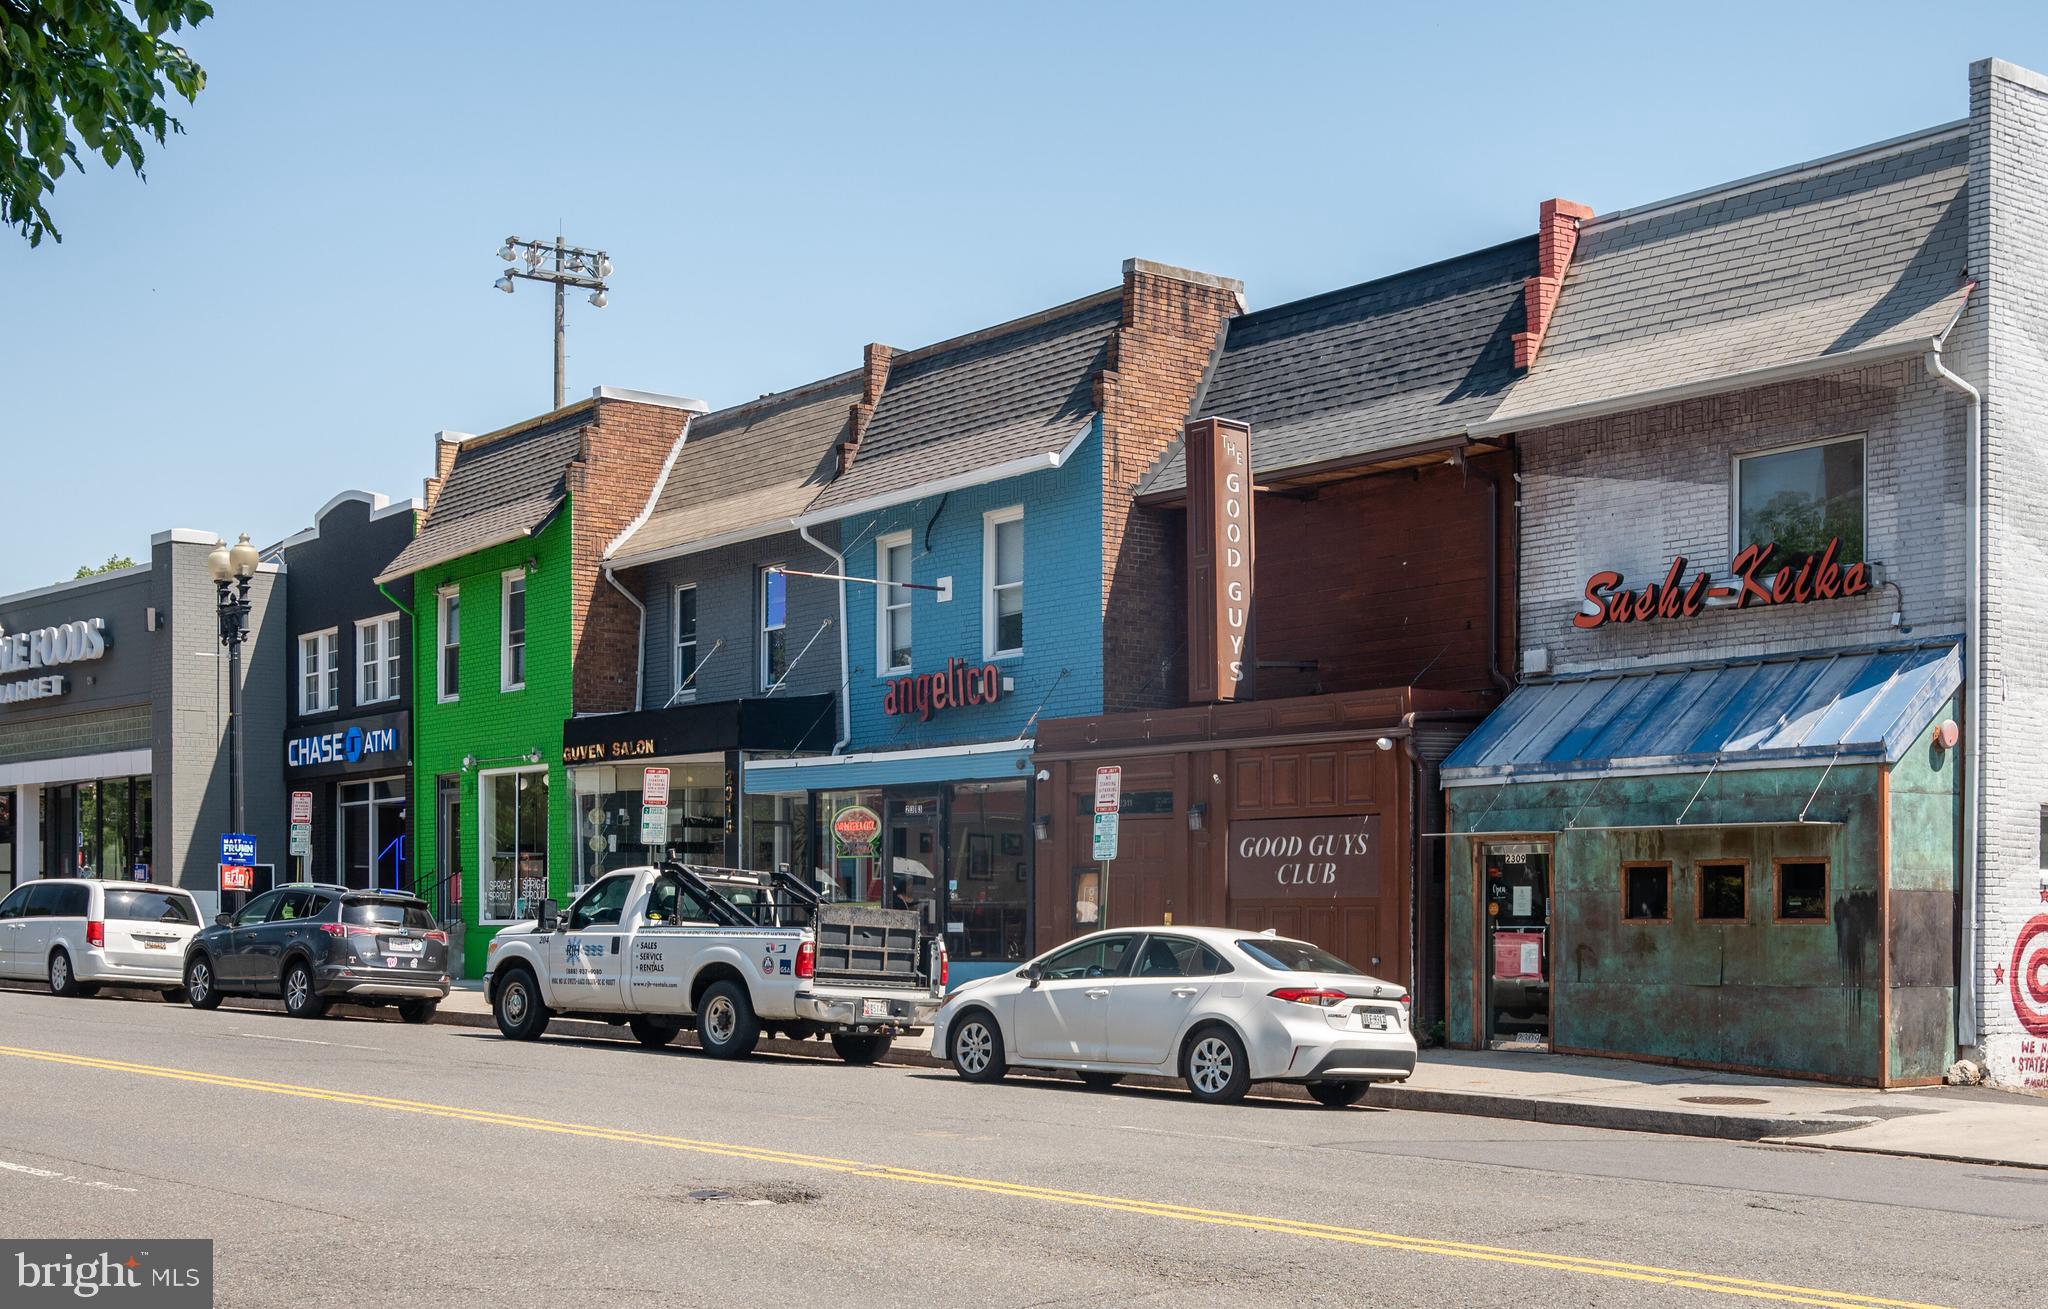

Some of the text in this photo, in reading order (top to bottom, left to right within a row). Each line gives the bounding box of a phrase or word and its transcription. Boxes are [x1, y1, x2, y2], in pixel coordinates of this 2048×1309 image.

[1220, 435, 1244, 681] THE GOOD GUYS
[884, 657, 998, 721] angelico
[288, 728, 393, 767] CHASE ATM
[563, 739, 655, 762] GUVEN SALON
[1240, 832, 1369, 859] GOOD GUYS
[1505, 854, 1526, 863] 2309
[1277, 862, 1337, 885] CLUB
[489, 880, 507, 890] SPRIG
[523, 879, 541, 890] SPRIG
[488, 891, 511, 901] SPROUT
[522, 890, 546, 900] SPROUT
[539, 935, 550, 944] 204
[640, 941, 657, 950] SALES
[639, 952, 662, 961] SERVICE
[639, 963, 664, 972] RENTALS
[2021, 1041, 2035, 1053] WE
